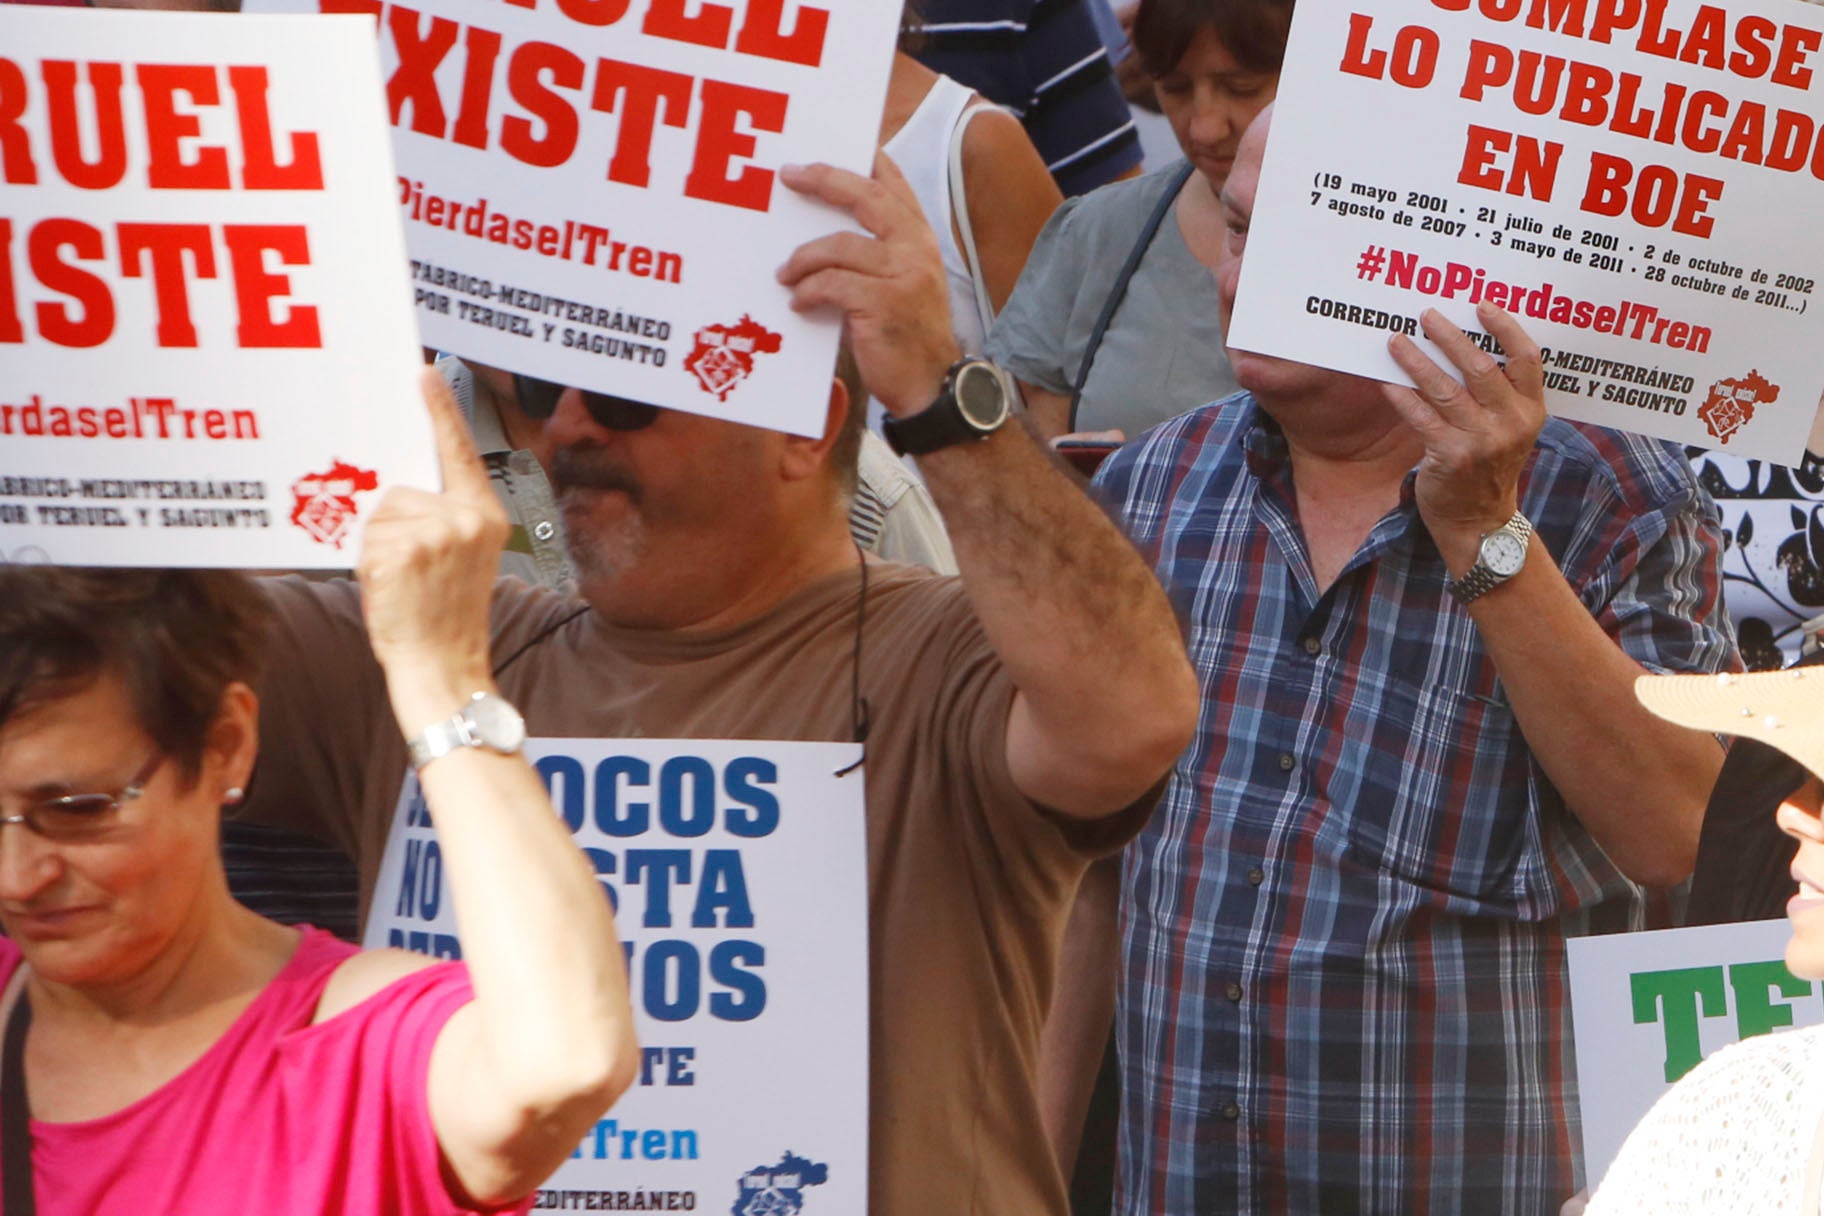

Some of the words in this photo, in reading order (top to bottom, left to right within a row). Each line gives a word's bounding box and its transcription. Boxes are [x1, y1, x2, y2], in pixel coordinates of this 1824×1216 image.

[1339, 12, 1441, 90] LO
[1457, 124, 1564, 204] EN
[1580, 150, 1725, 240] BOE
[1310, 190, 1321, 206] 7
[1327, 197, 1385, 222] agosto
[1392, 208, 1413, 226] de
[1421, 215, 1466, 239] 2007
[1491, 230, 1502, 246] 3
[1510, 238, 1556, 262] mayo
[1563, 246, 1583, 264] de
[1589, 252, 1624, 273] 2011
[1644, 265, 1666, 283] 28
[1671, 271, 1726, 297] octubre
[1732, 282, 1752, 301] de
[1314, 172, 1342, 190] (19
[1350, 183, 1398, 208] mayo
[1406, 191, 1448, 214] 2001
[1476, 207, 1497, 224] 21
[1503, 213, 1544, 235] julio
[1552, 224, 1573, 241] de
[1581, 230, 1620, 252] 2001
[1643, 245, 1655, 260] 2
[1662, 248, 1682, 265] de
[1688, 255, 1742, 280] octubre
[1750, 267, 1769, 284] de
[1775, 273, 1815, 294] 2002
[414, 287, 450, 315] POR
[458, 300, 533, 337] TERUEL
[542, 323, 554, 342] Y
[561, 327, 668, 368] SAGUNTO
[1306, 295, 1418, 336] CORREDOR
[1356, 244, 1713, 354] #NoPierdaselTren
[1587, 382, 1598, 400] Y
[1602, 386, 1688, 417] SAGUNTO
